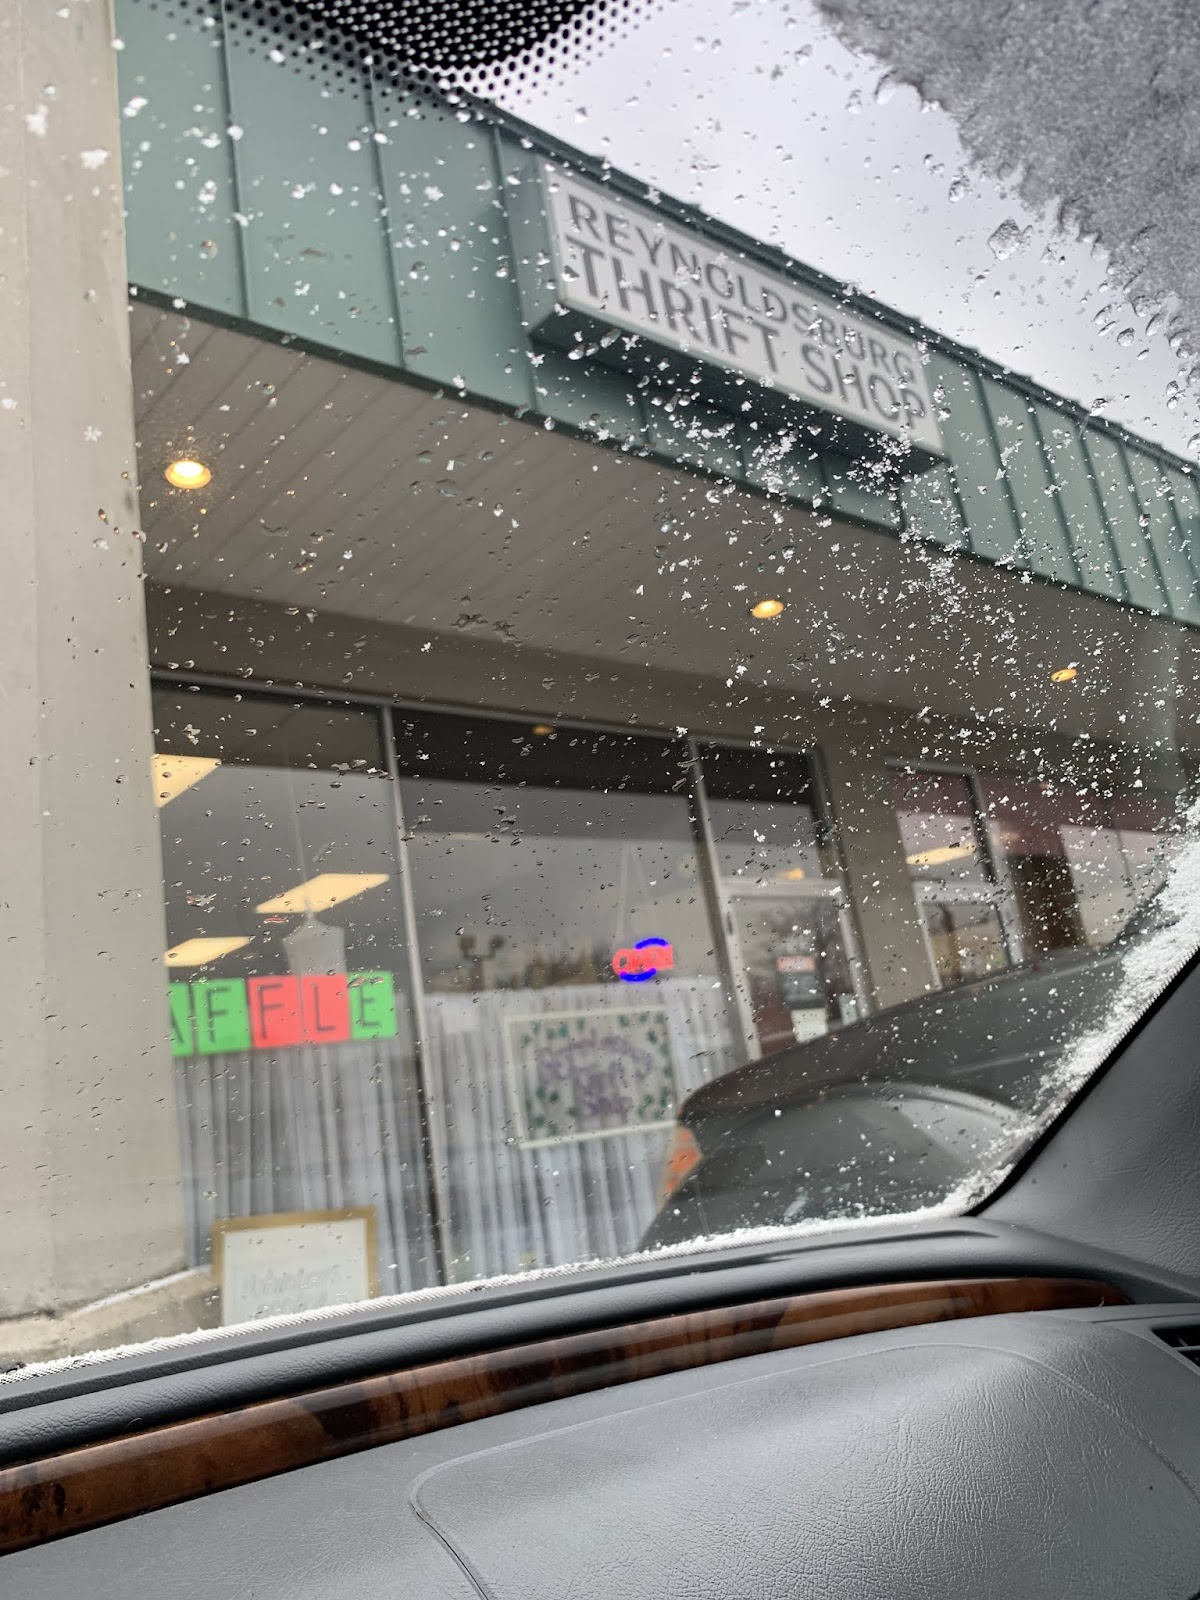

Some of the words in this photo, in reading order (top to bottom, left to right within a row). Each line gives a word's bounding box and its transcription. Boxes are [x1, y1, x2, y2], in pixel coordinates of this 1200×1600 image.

[567, 235, 781, 374] THRIFT
[800, 344, 927, 431] SHOP
[568, 195, 916, 384] REYNOLDSBURG
